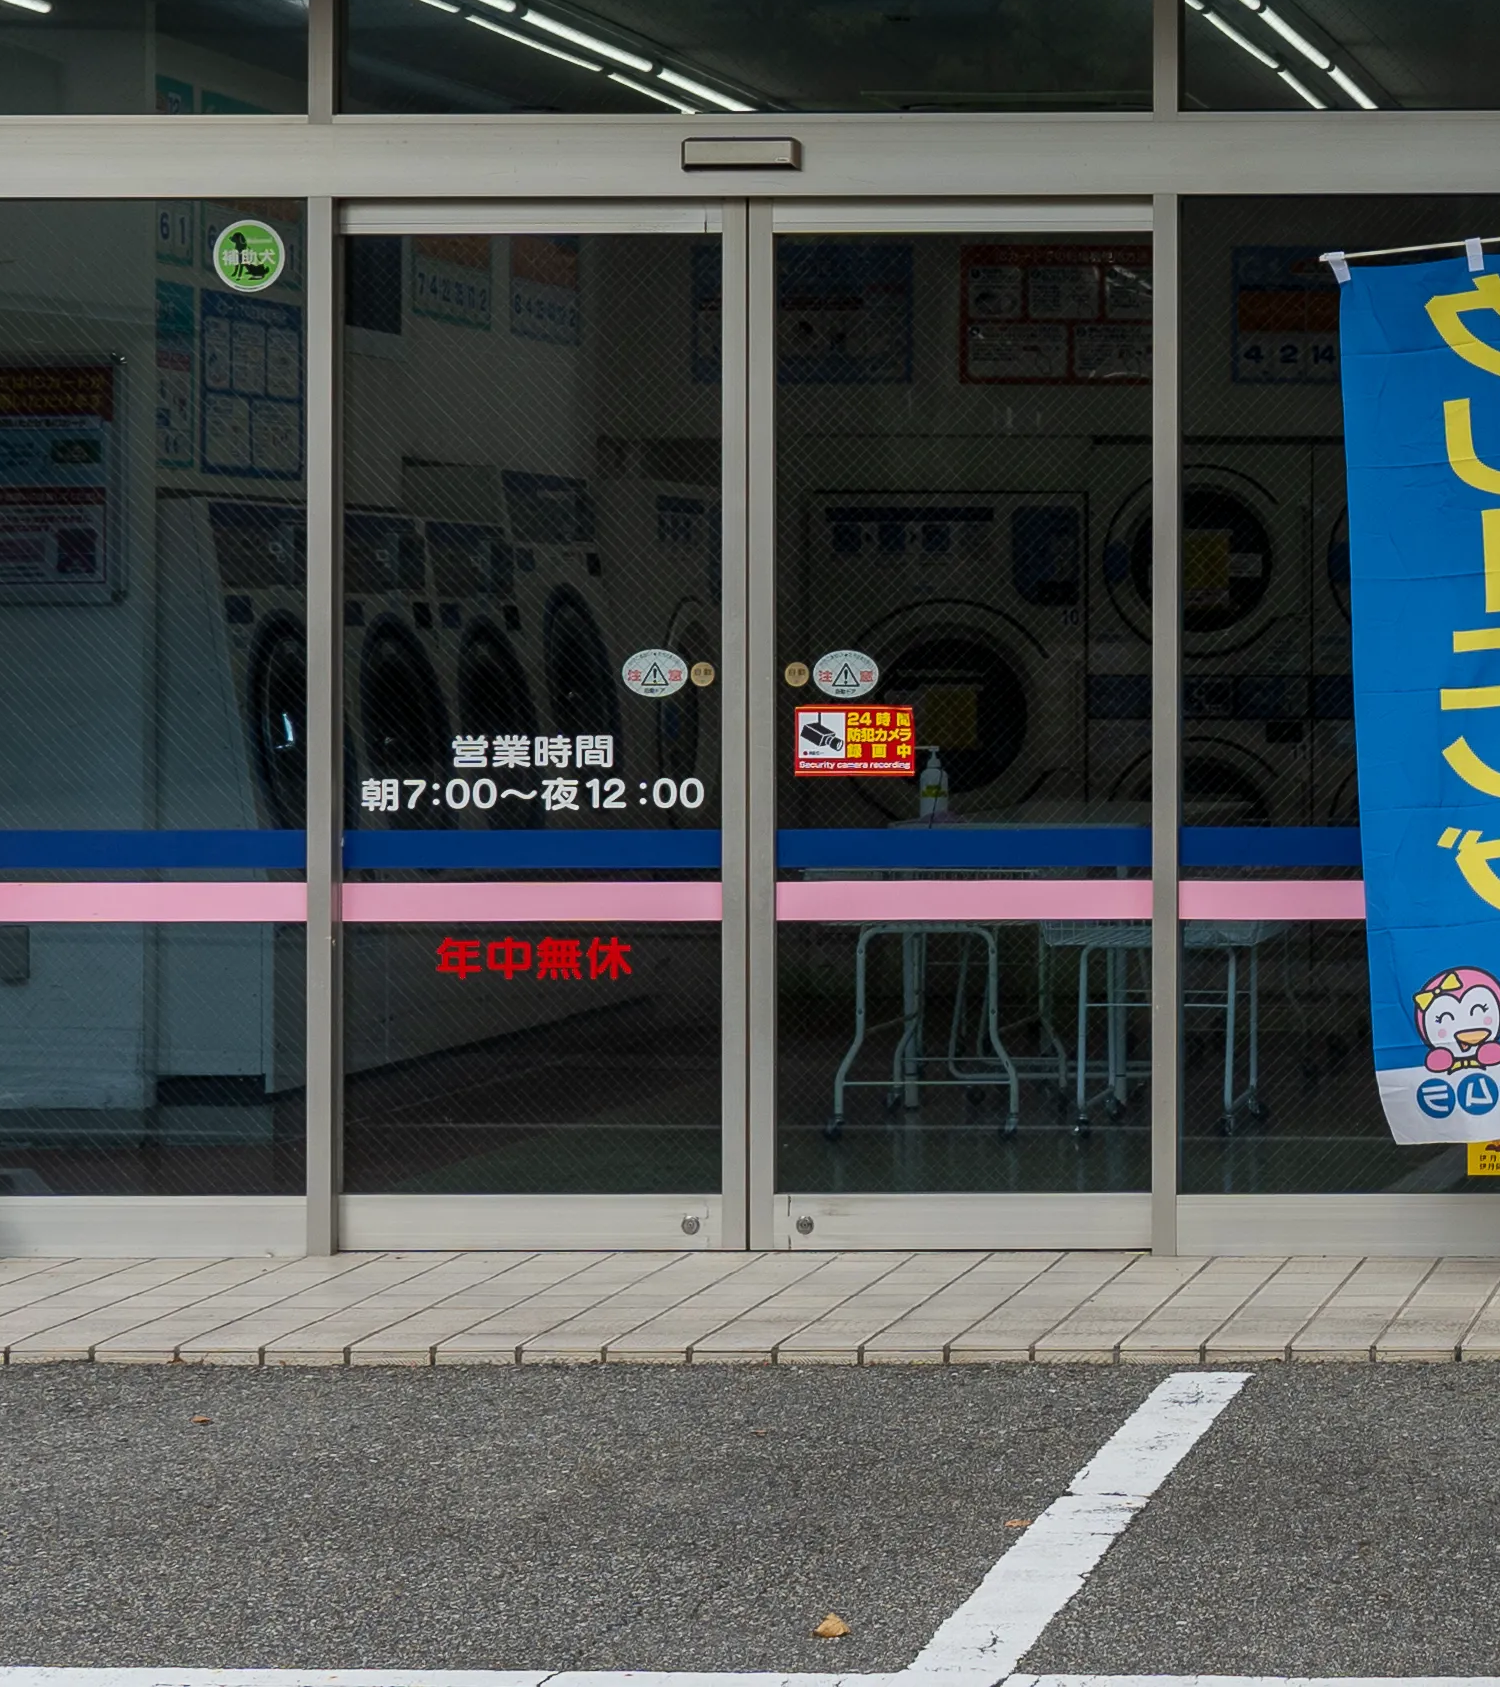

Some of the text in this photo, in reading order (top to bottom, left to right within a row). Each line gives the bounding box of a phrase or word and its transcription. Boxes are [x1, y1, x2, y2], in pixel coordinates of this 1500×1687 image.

[222, 248, 276, 266] 補助犬
[1243, 345, 1336, 364] 4 2 14
[846, 711, 911, 727] 24時間
[846, 727, 912, 743] 防犯カメラ
[451, 734, 615, 769] 営業時間
[846, 743, 912, 759] 録画中
[799, 760, 911, 770] Security camera recording
[435, 936, 633, 981] 年中無休
